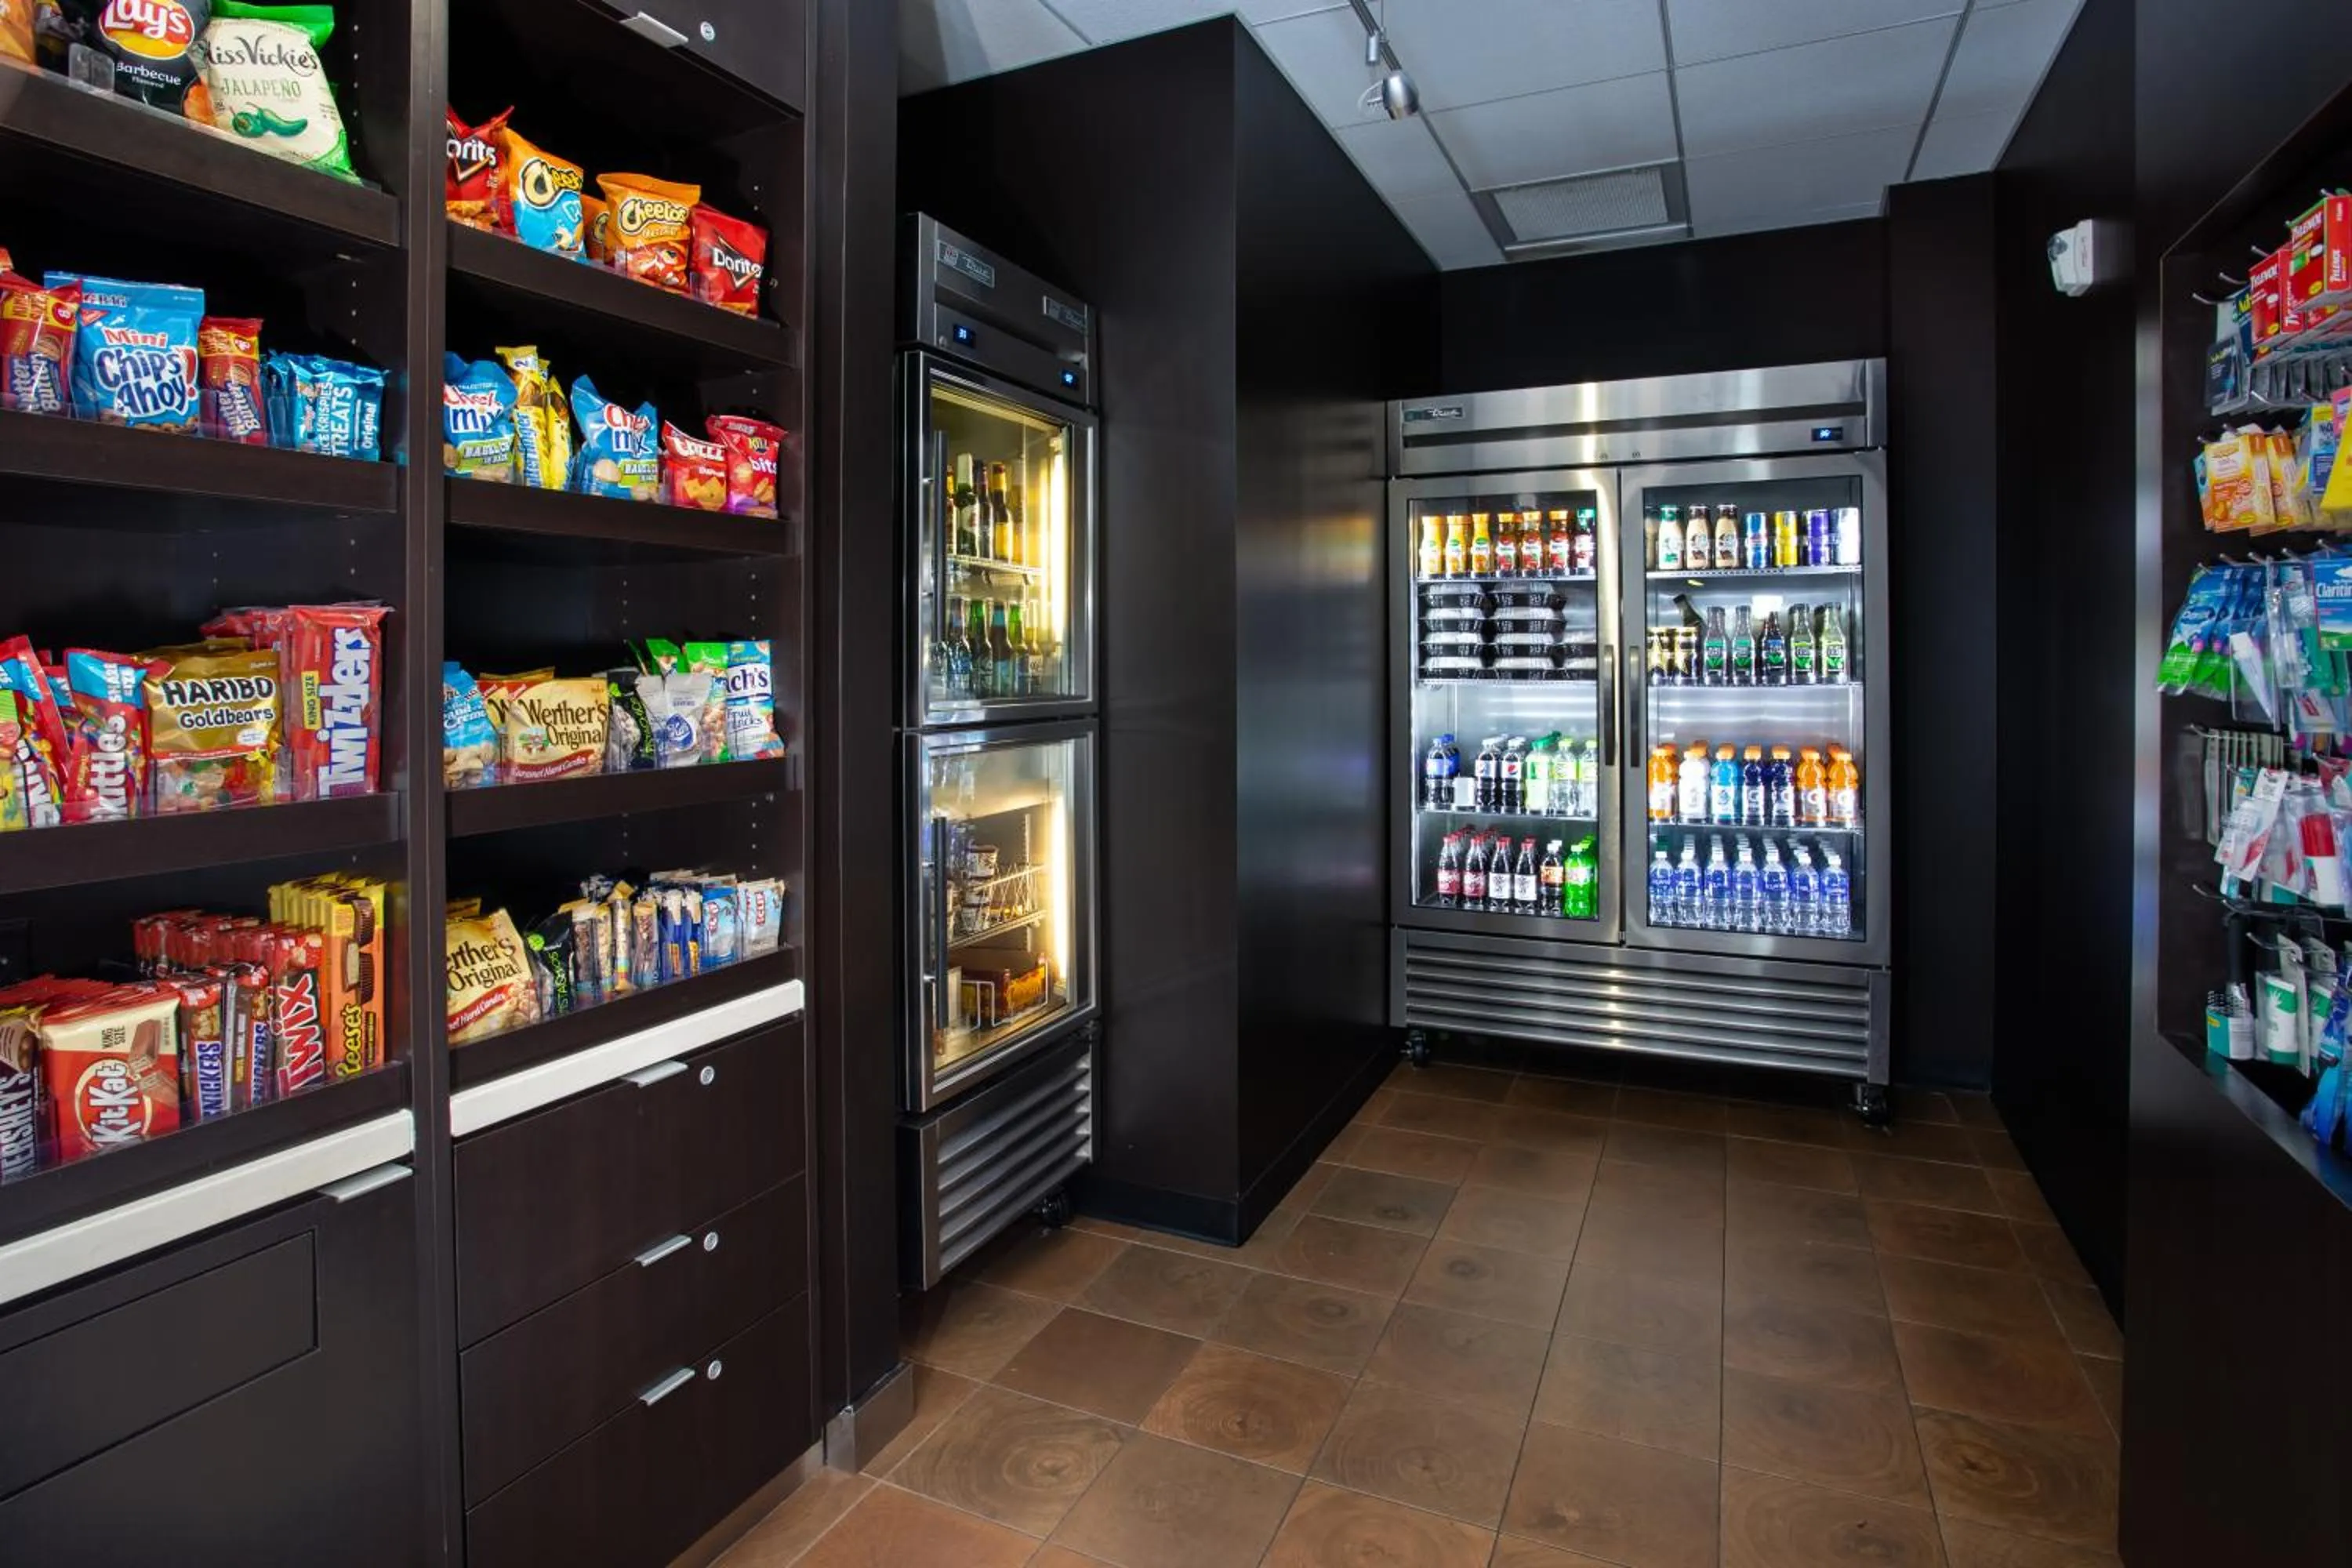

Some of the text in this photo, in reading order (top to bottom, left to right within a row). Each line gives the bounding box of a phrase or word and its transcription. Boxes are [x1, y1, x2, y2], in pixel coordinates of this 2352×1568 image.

[115, 61, 182, 85] Barbecue
[236, 34, 318, 77] Vickie's
[621, 198, 687, 233] Cheetos
[713, 247, 764, 278] Doritos
[102, 327, 168, 348] Mini
[94, 349, 183, 390] Chips
[315, 376, 334, 430] KRISPIES
[331, 386, 352, 457] TREATS
[361, 402, 377, 449] Original
[516, 412, 541, 487] utterfinger
[161, 677, 276, 708] HARIBO
[726, 668, 769, 693] ch's
[304, 673, 316, 726] KING SIZE
[517, 699, 608, 726] Werther's
[179, 707, 274, 729] Goldbears
[546, 722, 605, 750] Original
[447, 936, 517, 971] rther's
[447, 956, 523, 993] Original
[336, 1004, 364, 1077] Reese's
